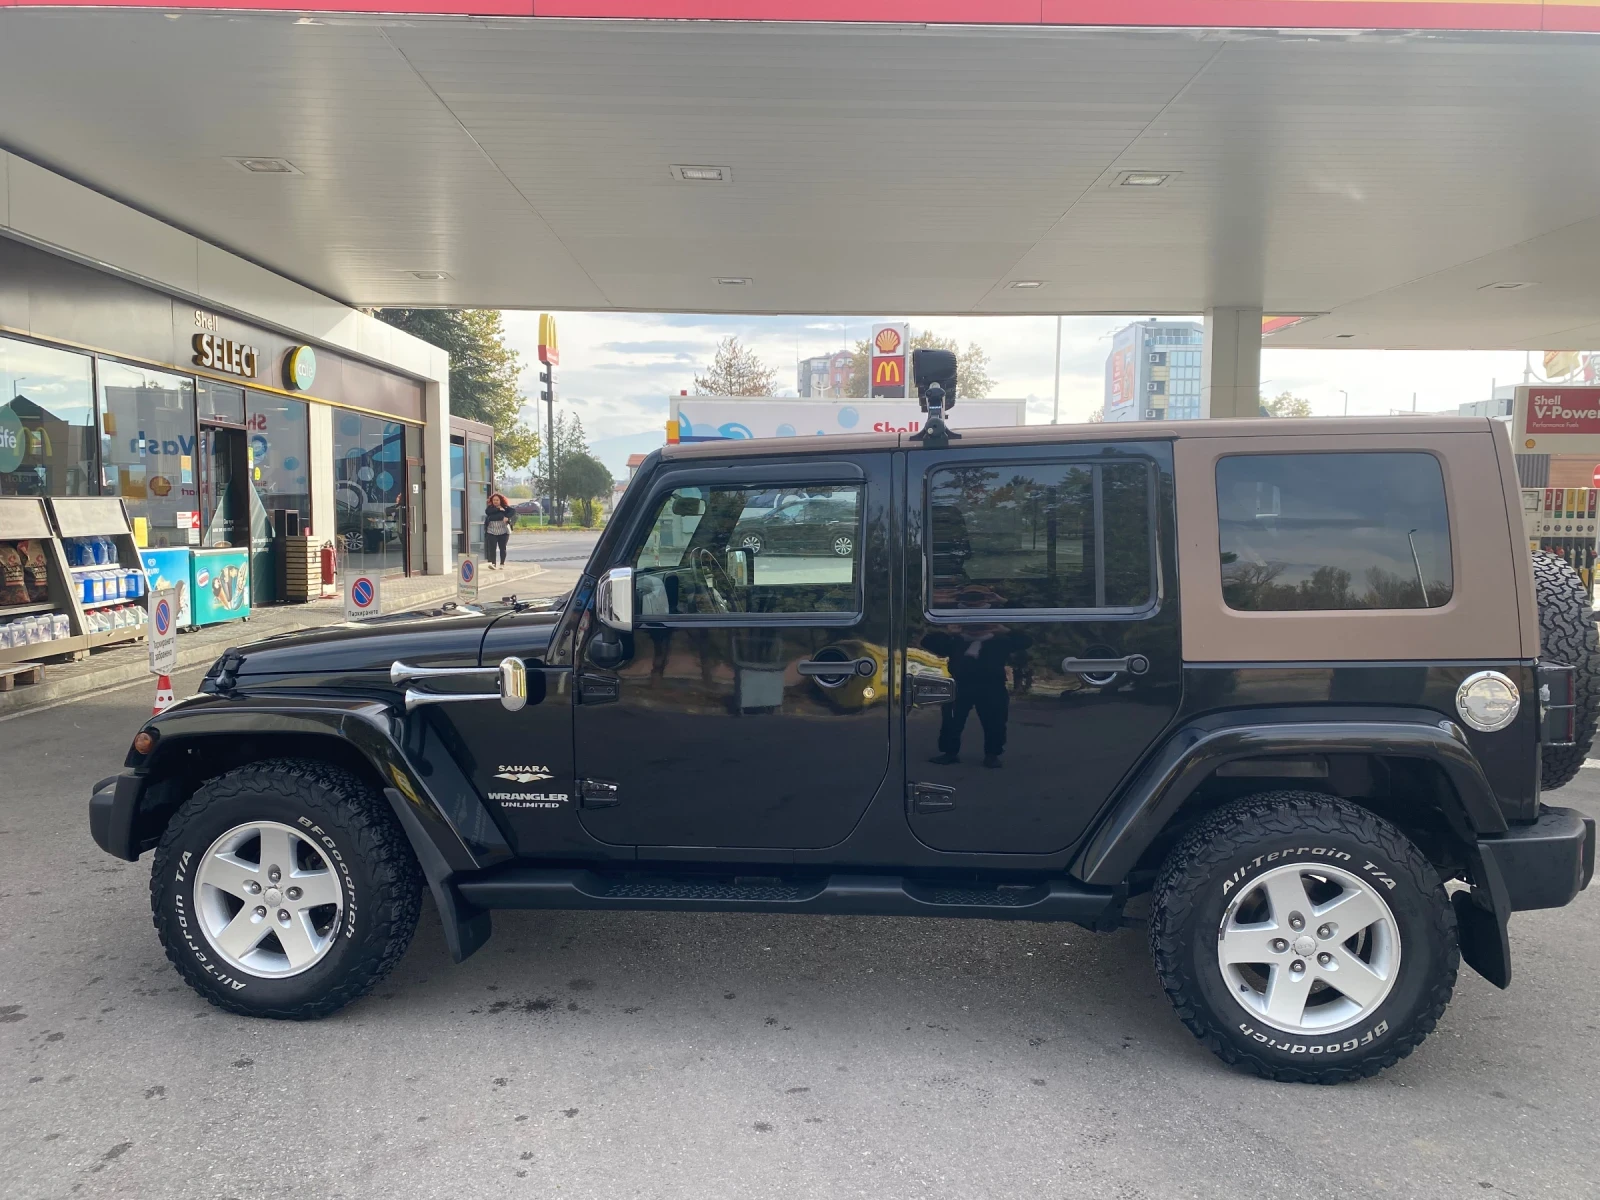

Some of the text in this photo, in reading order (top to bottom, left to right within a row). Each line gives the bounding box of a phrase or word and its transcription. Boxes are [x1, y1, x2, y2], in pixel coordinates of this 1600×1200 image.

[195, 310, 218, 332] Shell
[202, 333, 260, 378] SELECT
[1534, 395, 1561, 405] Shell
[498, 765, 550, 773] SAHARA
[487, 792, 569, 802] WRANGLER
[297, 815, 359, 940] BFGoodrich
[1222, 846, 1398, 895] All-Terrain T/A
[173, 849, 247, 992] All-Terrain T/A
[1237, 1020, 1389, 1056] BFGoodrich
